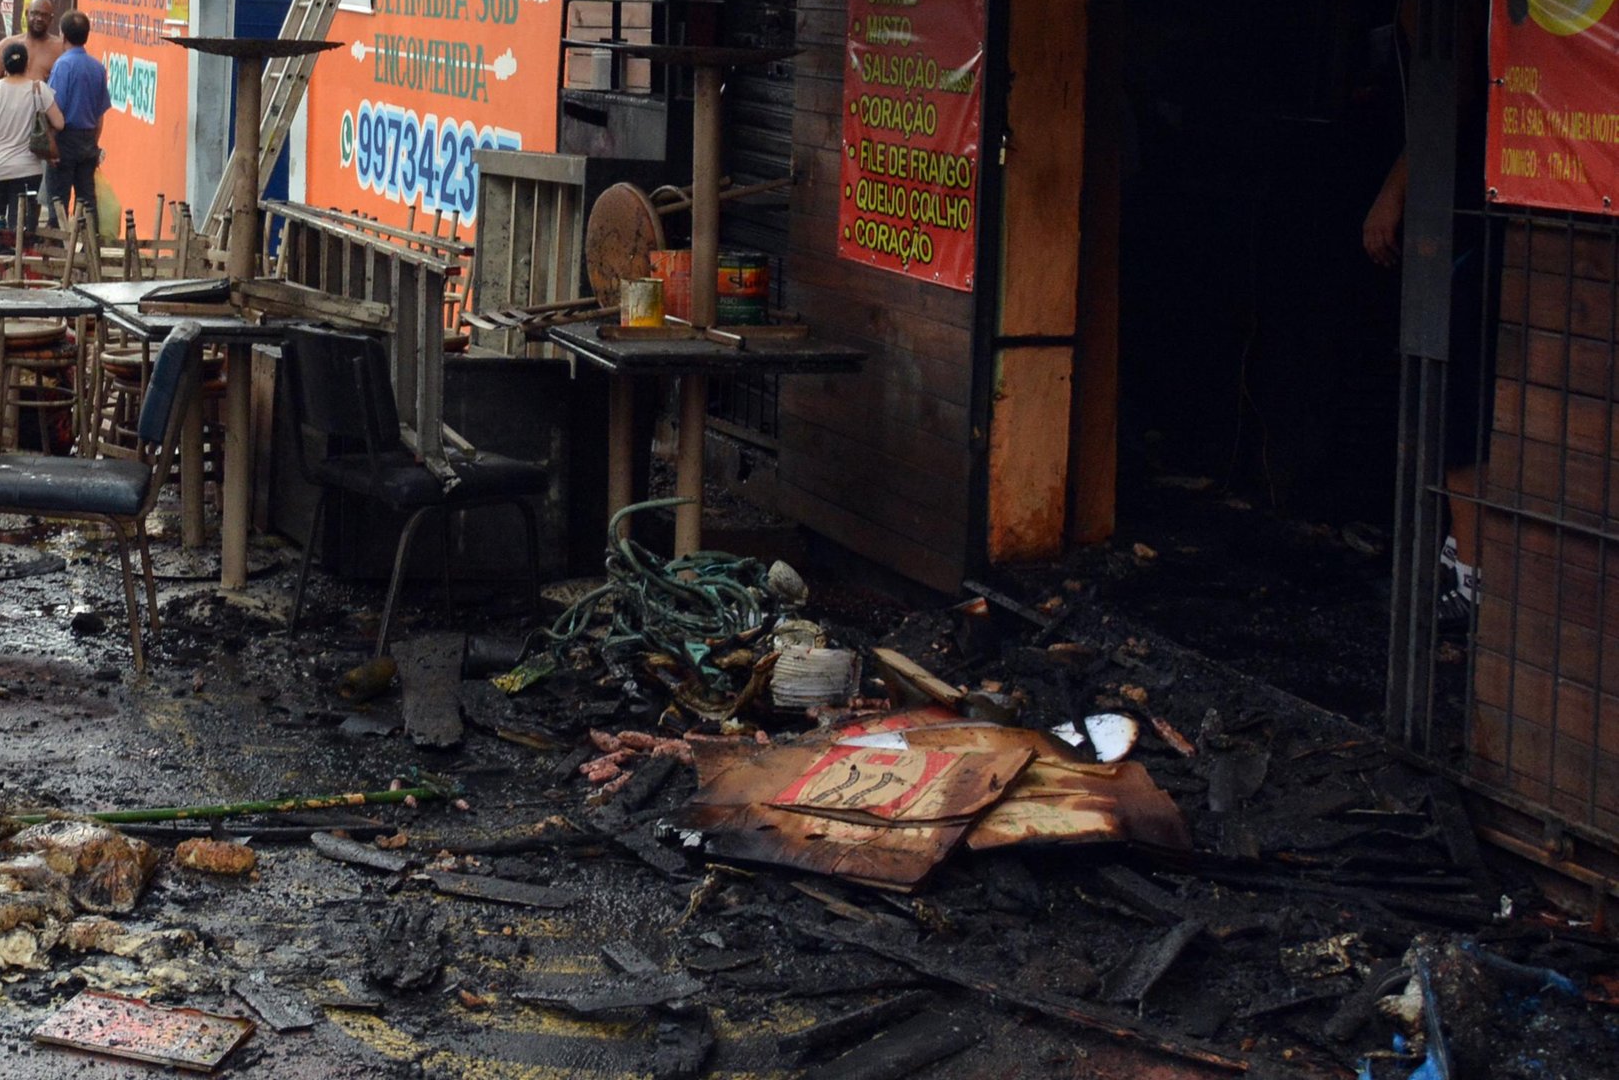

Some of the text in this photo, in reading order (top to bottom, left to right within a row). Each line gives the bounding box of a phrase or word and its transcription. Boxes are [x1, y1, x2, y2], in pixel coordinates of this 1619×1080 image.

[866, 15, 912, 47] MISTO
[374, 33, 489, 103] ENCOMENDA
[862, 53, 938, 94] SALSIÇÃO
[859, 94, 937, 140] CORAÇÃO
[358, 112, 518, 213] 99734-23
[888, 145, 908, 178] DE
[856, 178, 971, 231] QUEIJO COALHO
[854, 218, 933, 265] CORAÇÃO
